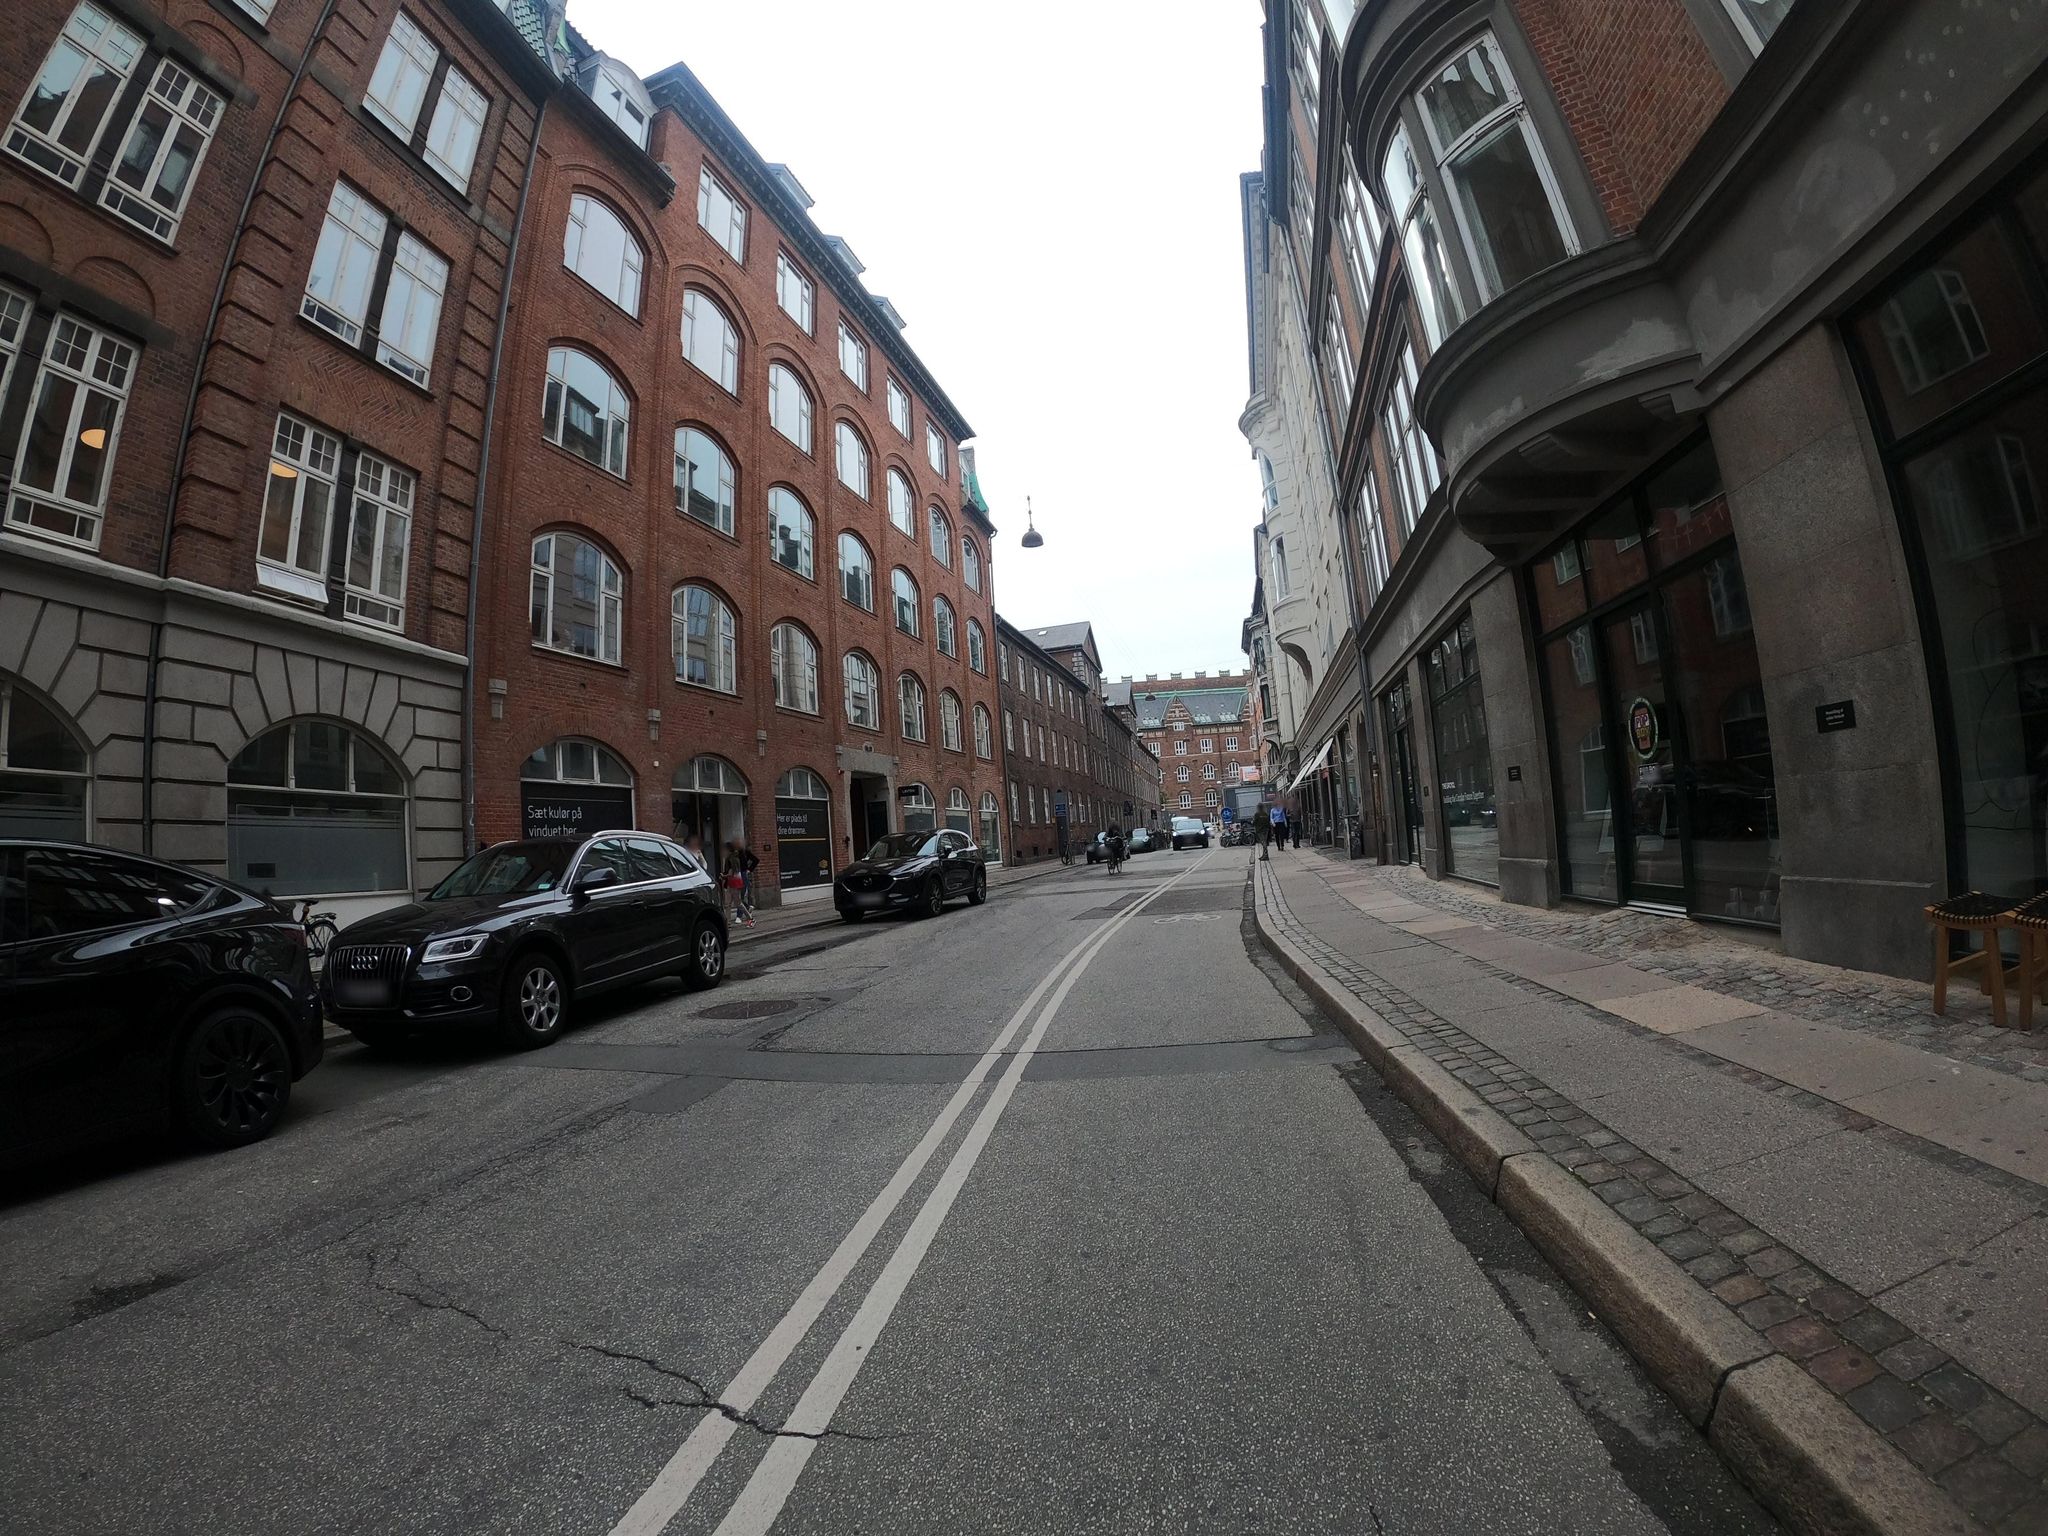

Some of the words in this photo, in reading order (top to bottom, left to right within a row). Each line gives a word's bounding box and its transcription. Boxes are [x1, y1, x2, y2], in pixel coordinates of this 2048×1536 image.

[528, 805, 547, 819] Sæt
[549, 805, 570, 819] kulør
[572, 806, 582, 822] på
[528, 824, 561, 838] vinduet
